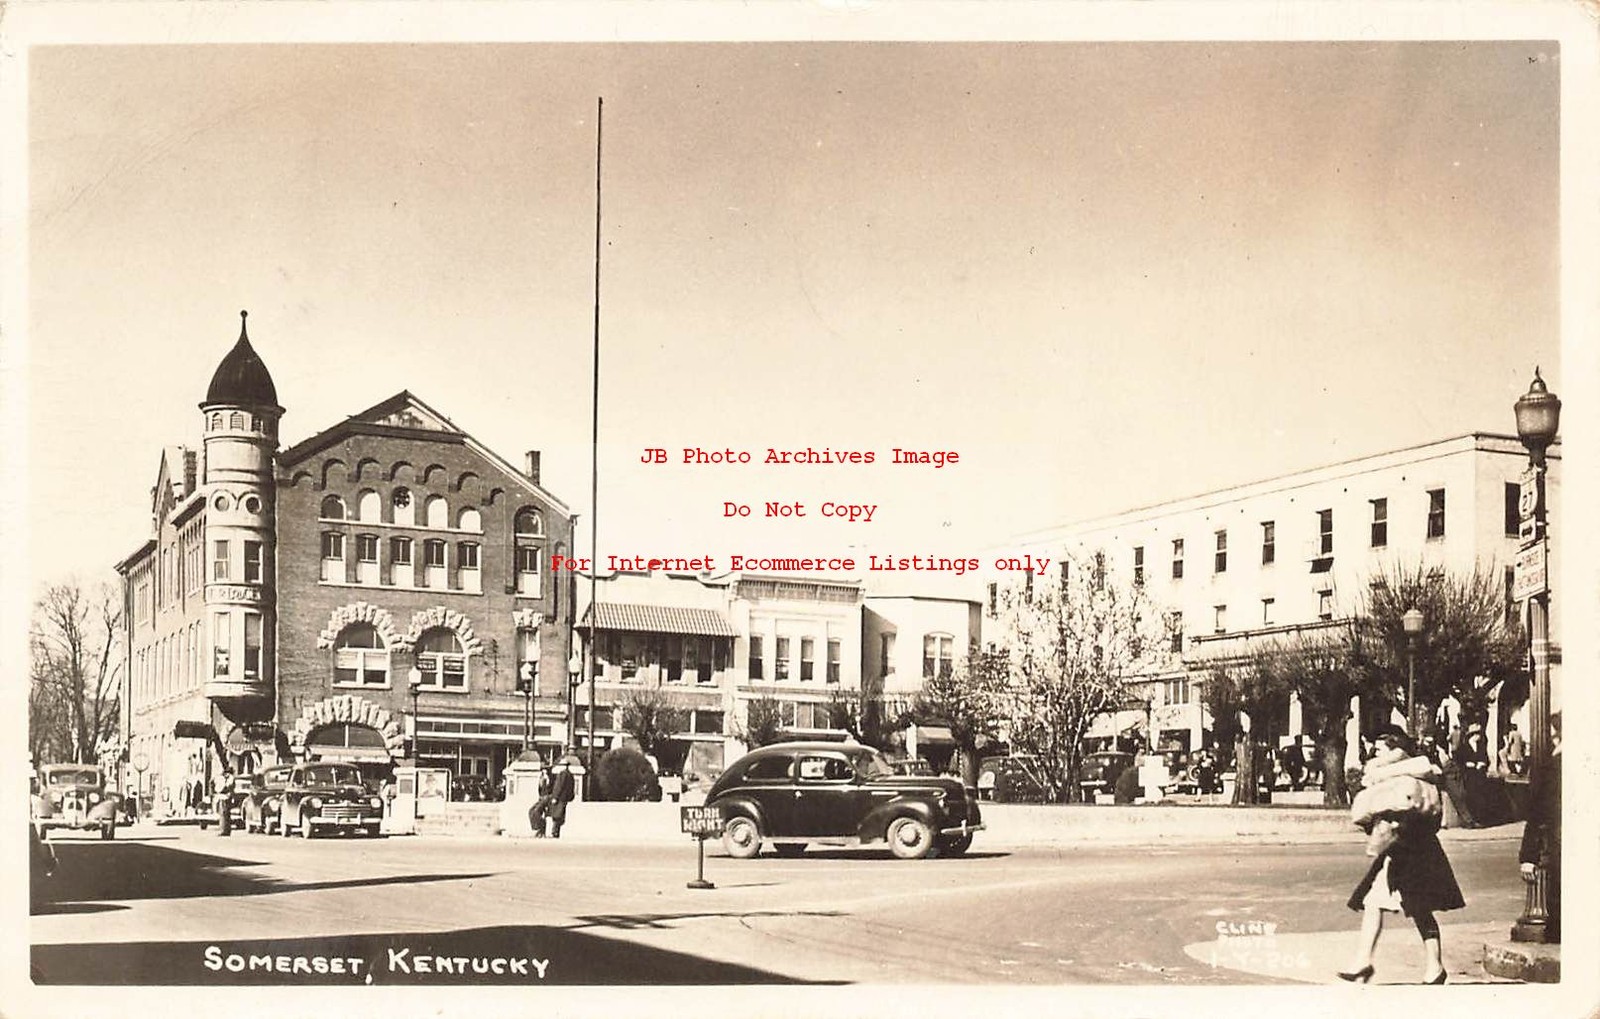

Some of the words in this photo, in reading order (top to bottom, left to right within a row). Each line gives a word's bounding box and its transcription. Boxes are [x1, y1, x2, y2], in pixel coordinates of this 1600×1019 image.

[1522, 491, 1534, 513] 27
[687, 807, 720, 819] TURN
[683, 818, 723, 831] RIGHT
